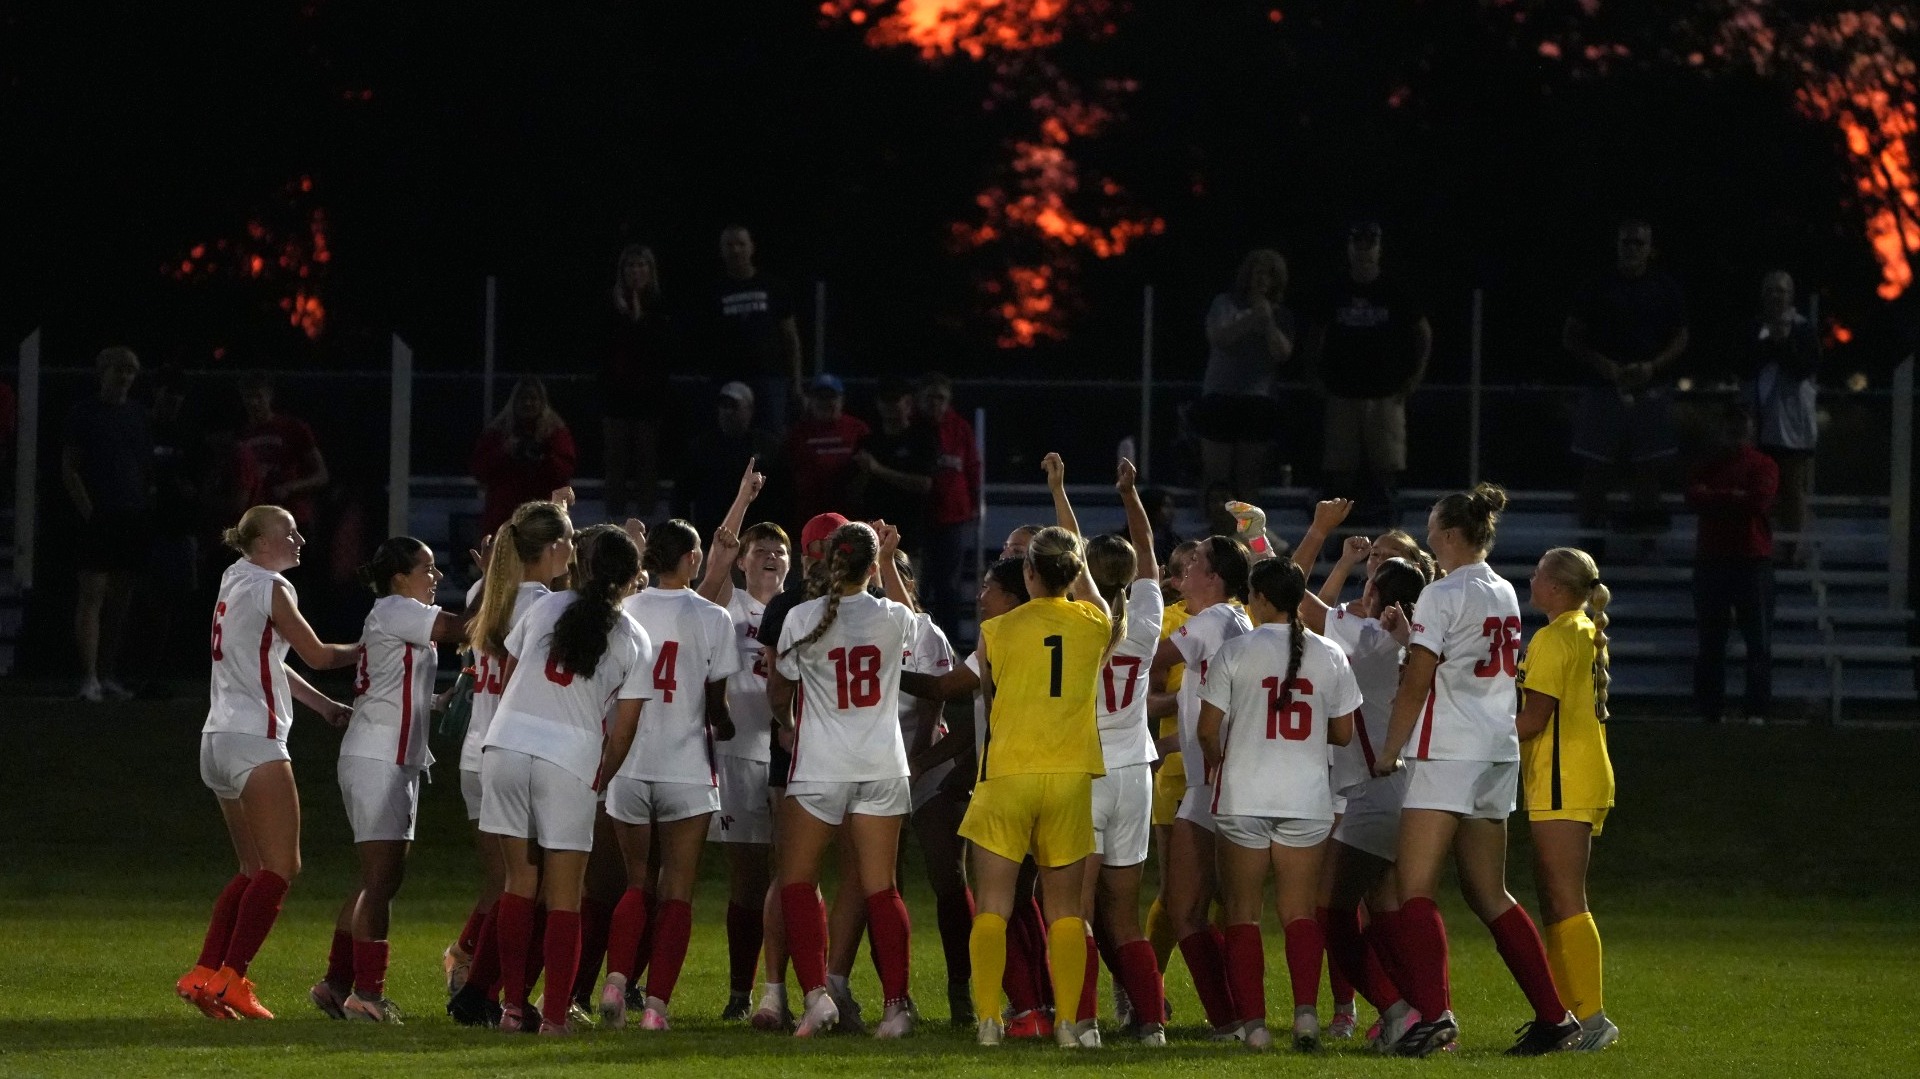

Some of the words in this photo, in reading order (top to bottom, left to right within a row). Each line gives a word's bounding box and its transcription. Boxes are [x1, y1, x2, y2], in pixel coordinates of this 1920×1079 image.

[653, 641, 679, 703] 4
[828, 645, 881, 709] 18
[1044, 635, 1063, 697] 1
[1474, 615, 1522, 678] 36
[1103, 655, 1142, 713] 17
[1262, 676, 1313, 740] 16
